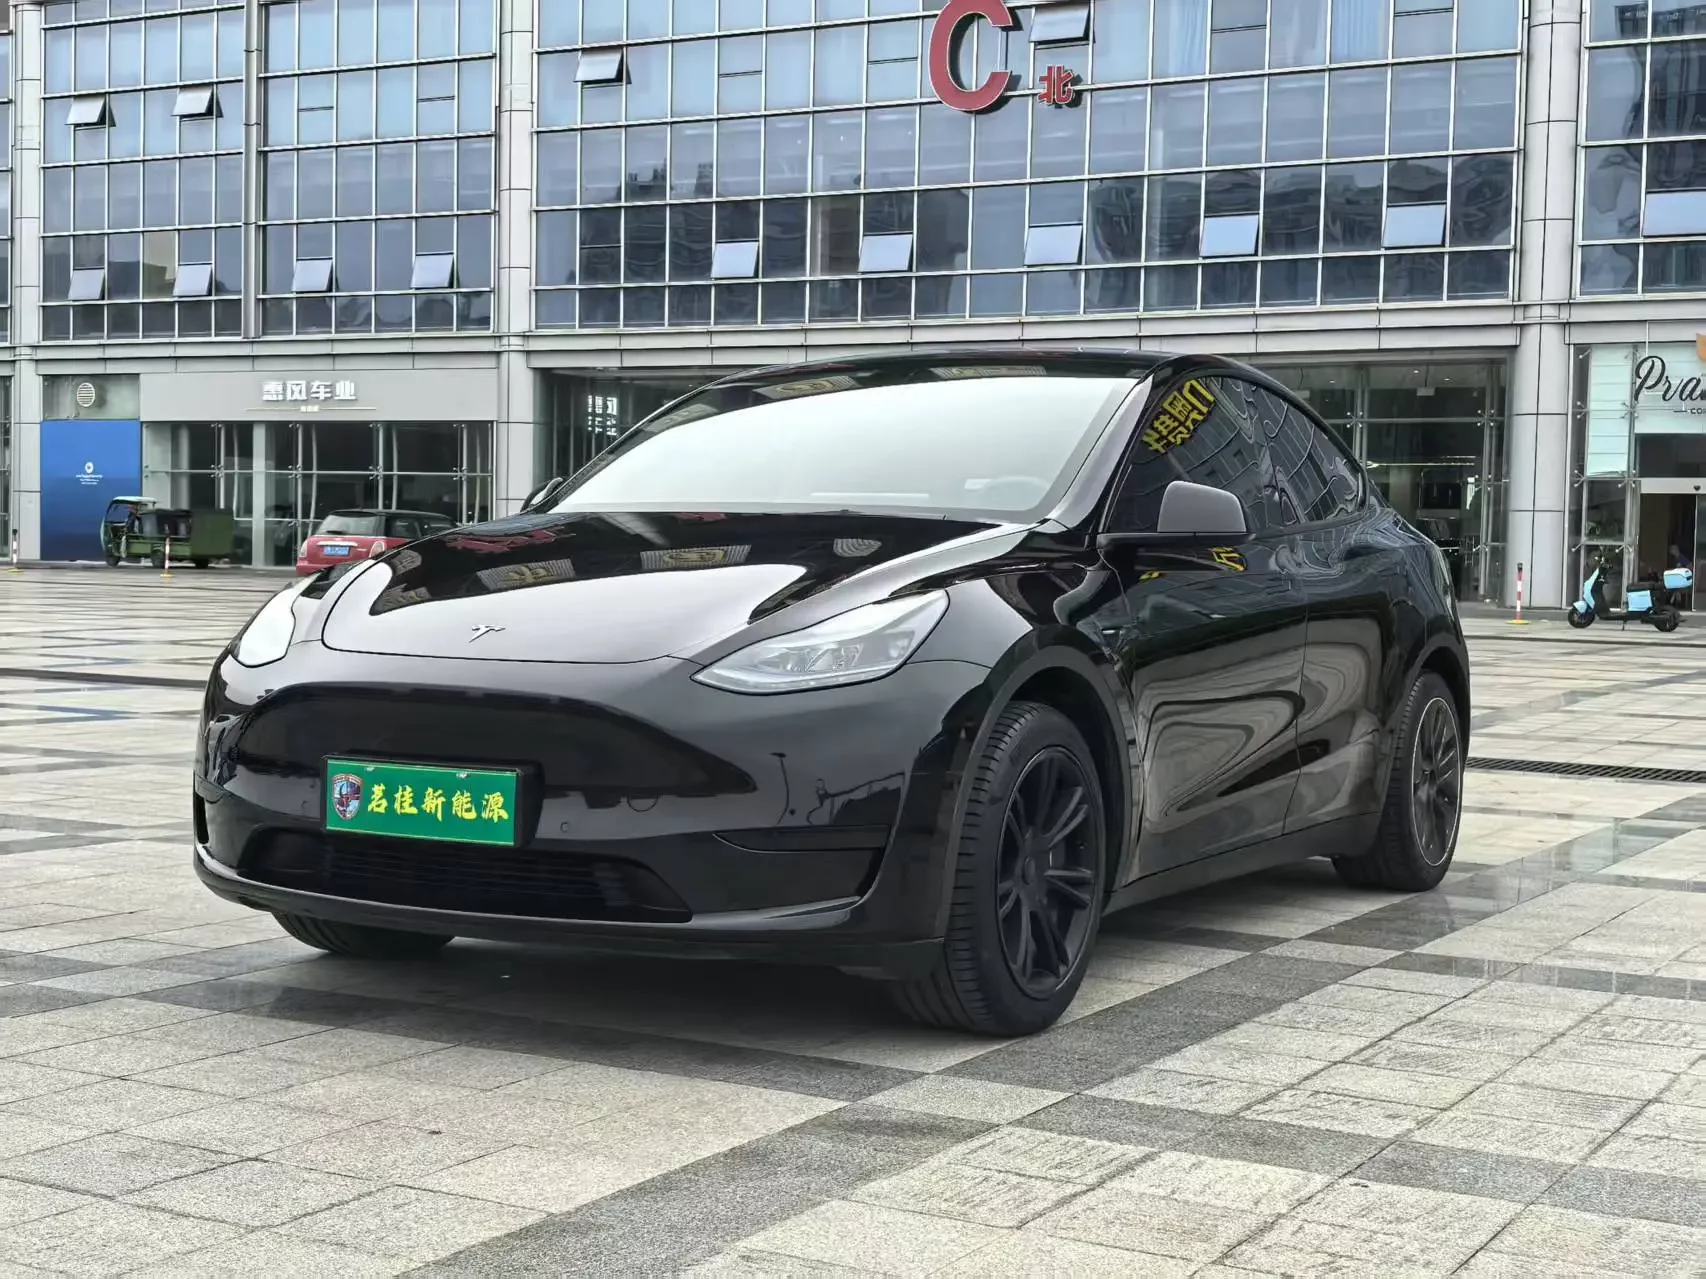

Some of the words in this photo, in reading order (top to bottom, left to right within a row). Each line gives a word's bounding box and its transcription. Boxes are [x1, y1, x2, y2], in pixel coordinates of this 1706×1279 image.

[929, 0, 1013, 111] C
[1038, 65, 1073, 104] 北
[1634, 355, 1706, 402] Pra
[1690, 407, 1706, 415] CO
